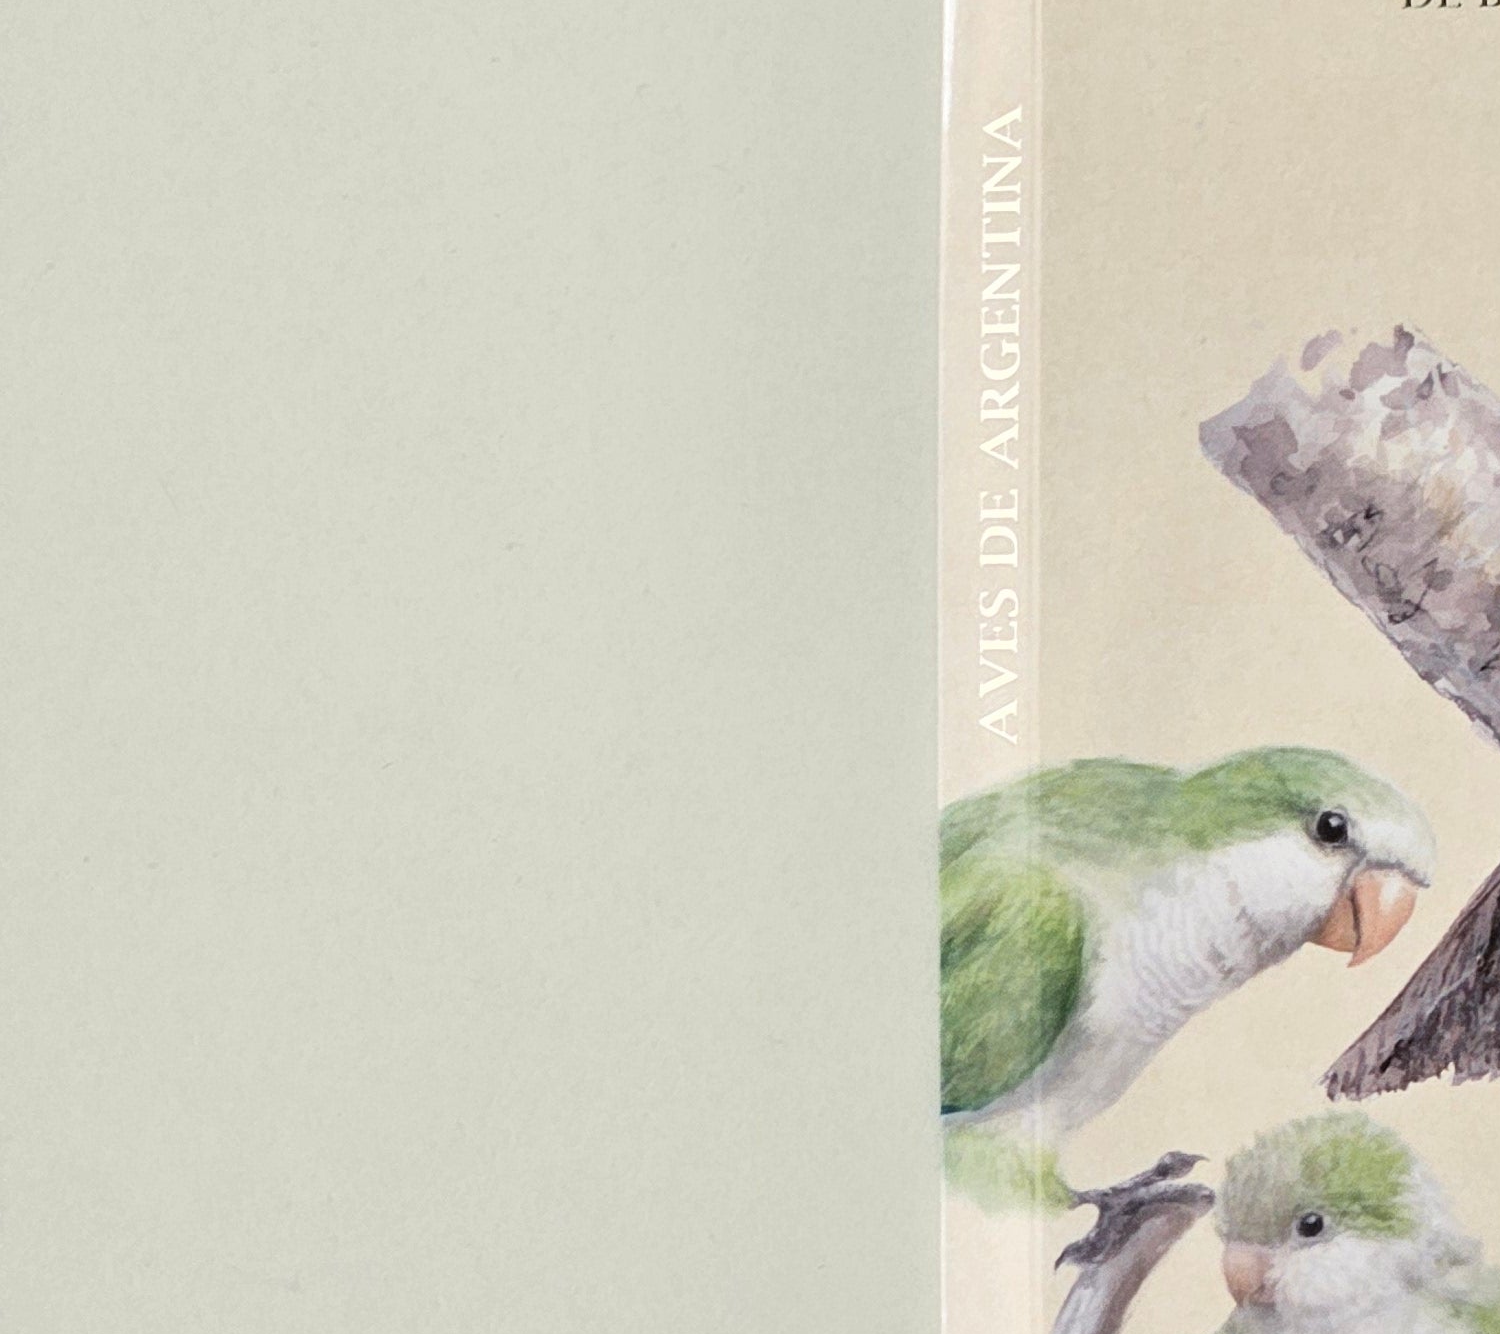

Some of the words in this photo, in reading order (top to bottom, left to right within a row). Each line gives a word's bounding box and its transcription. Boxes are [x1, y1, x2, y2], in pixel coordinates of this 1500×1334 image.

[979, 103, 1023, 470] ARGENTINA
[979, 488, 1019, 568] DE
[978, 587, 1020, 745] AVES
